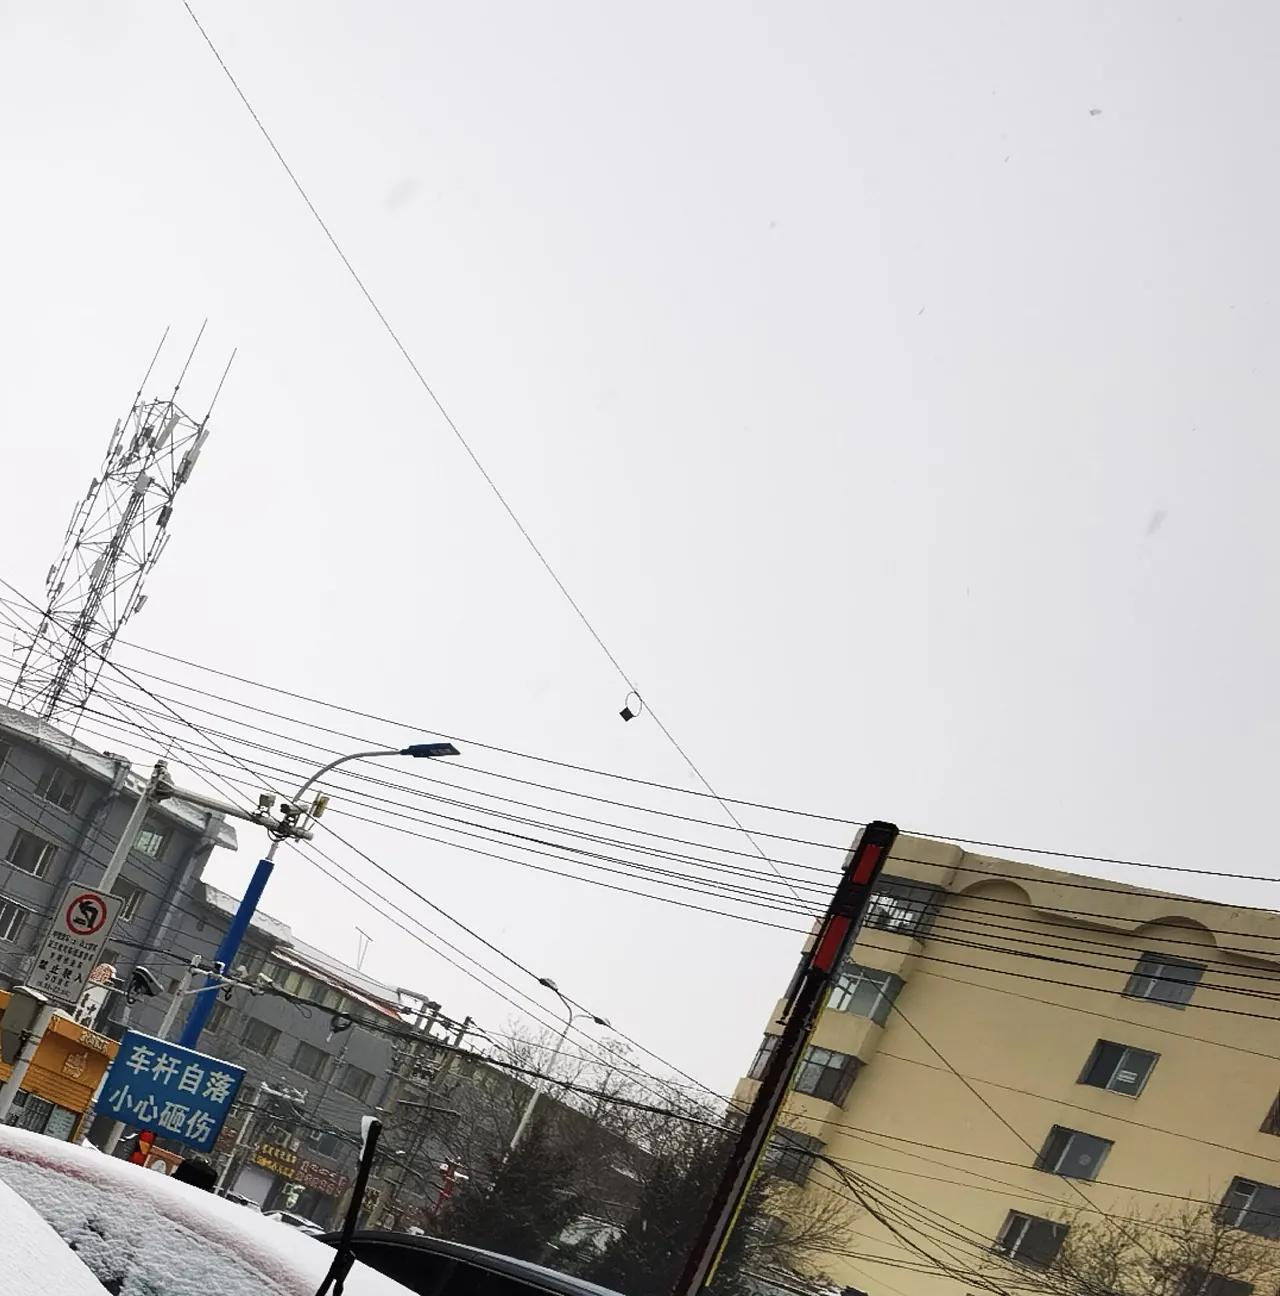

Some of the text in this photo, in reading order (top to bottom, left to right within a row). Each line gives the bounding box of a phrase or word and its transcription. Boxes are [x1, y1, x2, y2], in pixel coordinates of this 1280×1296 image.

[125, 1044, 236, 1104] 车杆自落
[108, 1084, 217, 1144] 小心砸伤
